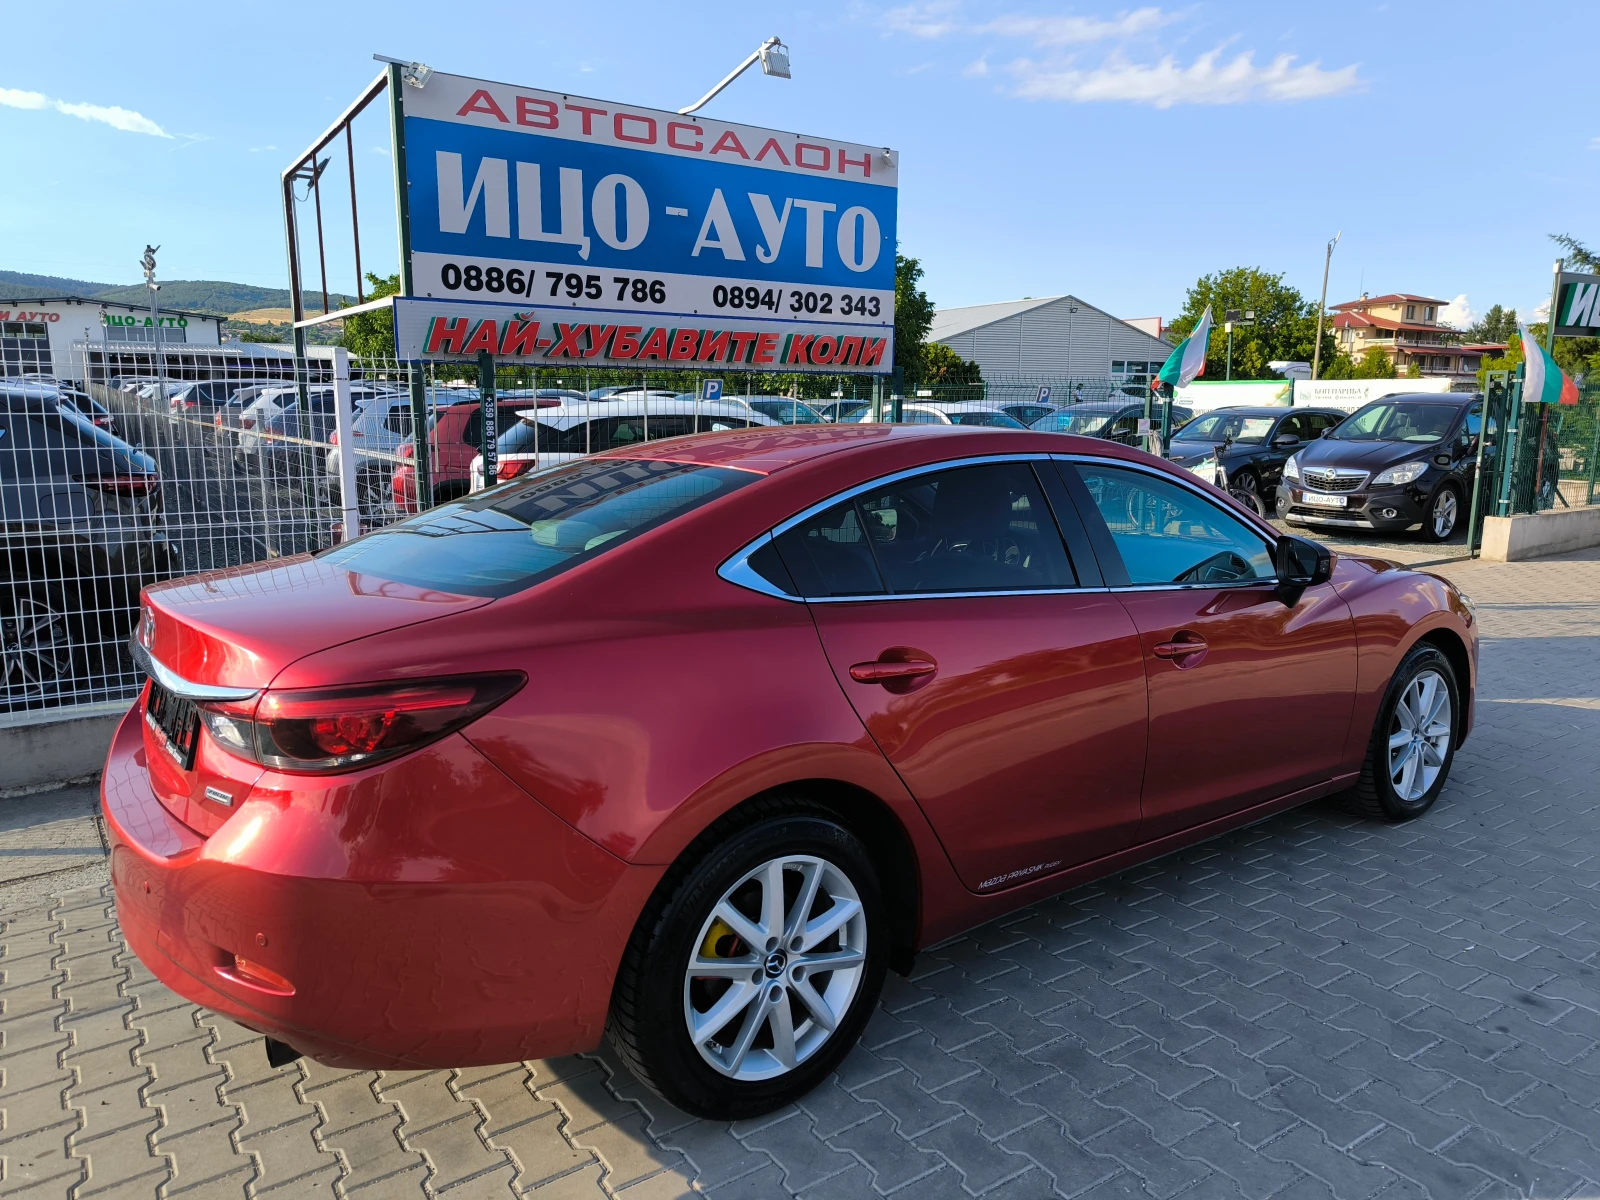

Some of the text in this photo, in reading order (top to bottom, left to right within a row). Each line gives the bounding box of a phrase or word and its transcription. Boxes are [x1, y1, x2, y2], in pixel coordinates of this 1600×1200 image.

[456, 89, 871, 178] АВТОСАЛОН
[441, 263, 667, 304] 0886/ 795 786
[713, 285, 881, 317] 0894/ 302 343
[16, 311, 60, 323] АУТО
[423, 311, 888, 366] НАЙ-ХУБАВИТЕ КОЛИ
[706, 381, 719, 398] P
[1039, 387, 1049, 401] P
[485, 396, 497, 476] +359 886 79 57 86
